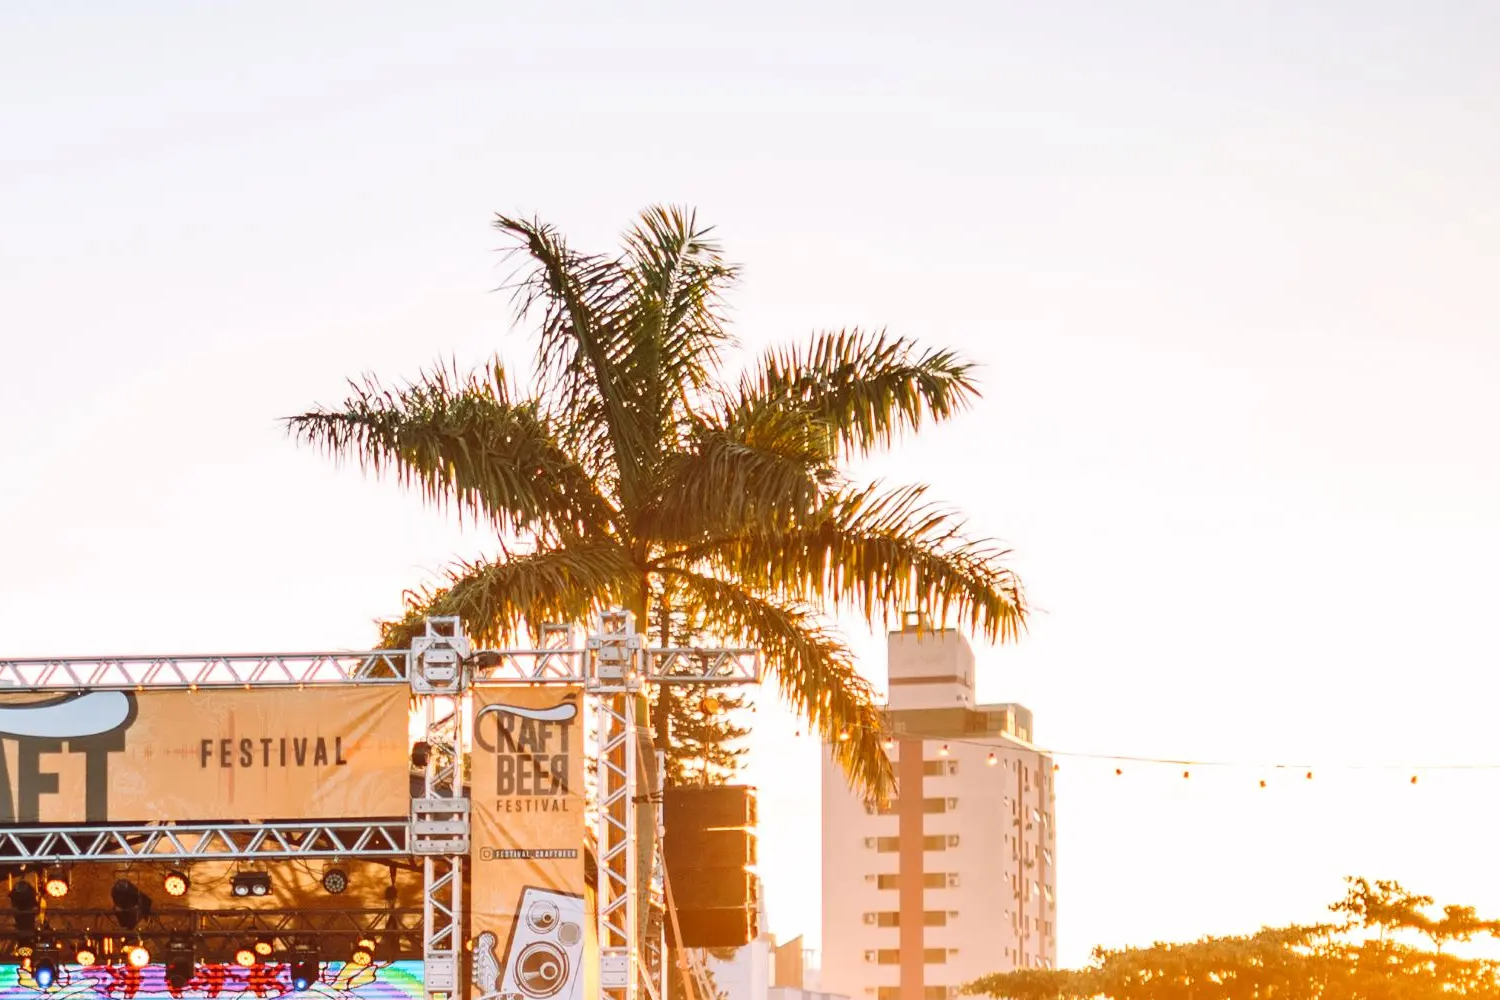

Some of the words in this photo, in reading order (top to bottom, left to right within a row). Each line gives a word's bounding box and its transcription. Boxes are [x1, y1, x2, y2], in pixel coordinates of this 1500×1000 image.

[474, 703, 577, 753] CRAFT
[201, 736, 348, 768] FESTIVAL
[496, 798, 569, 813] FESTIVAL
